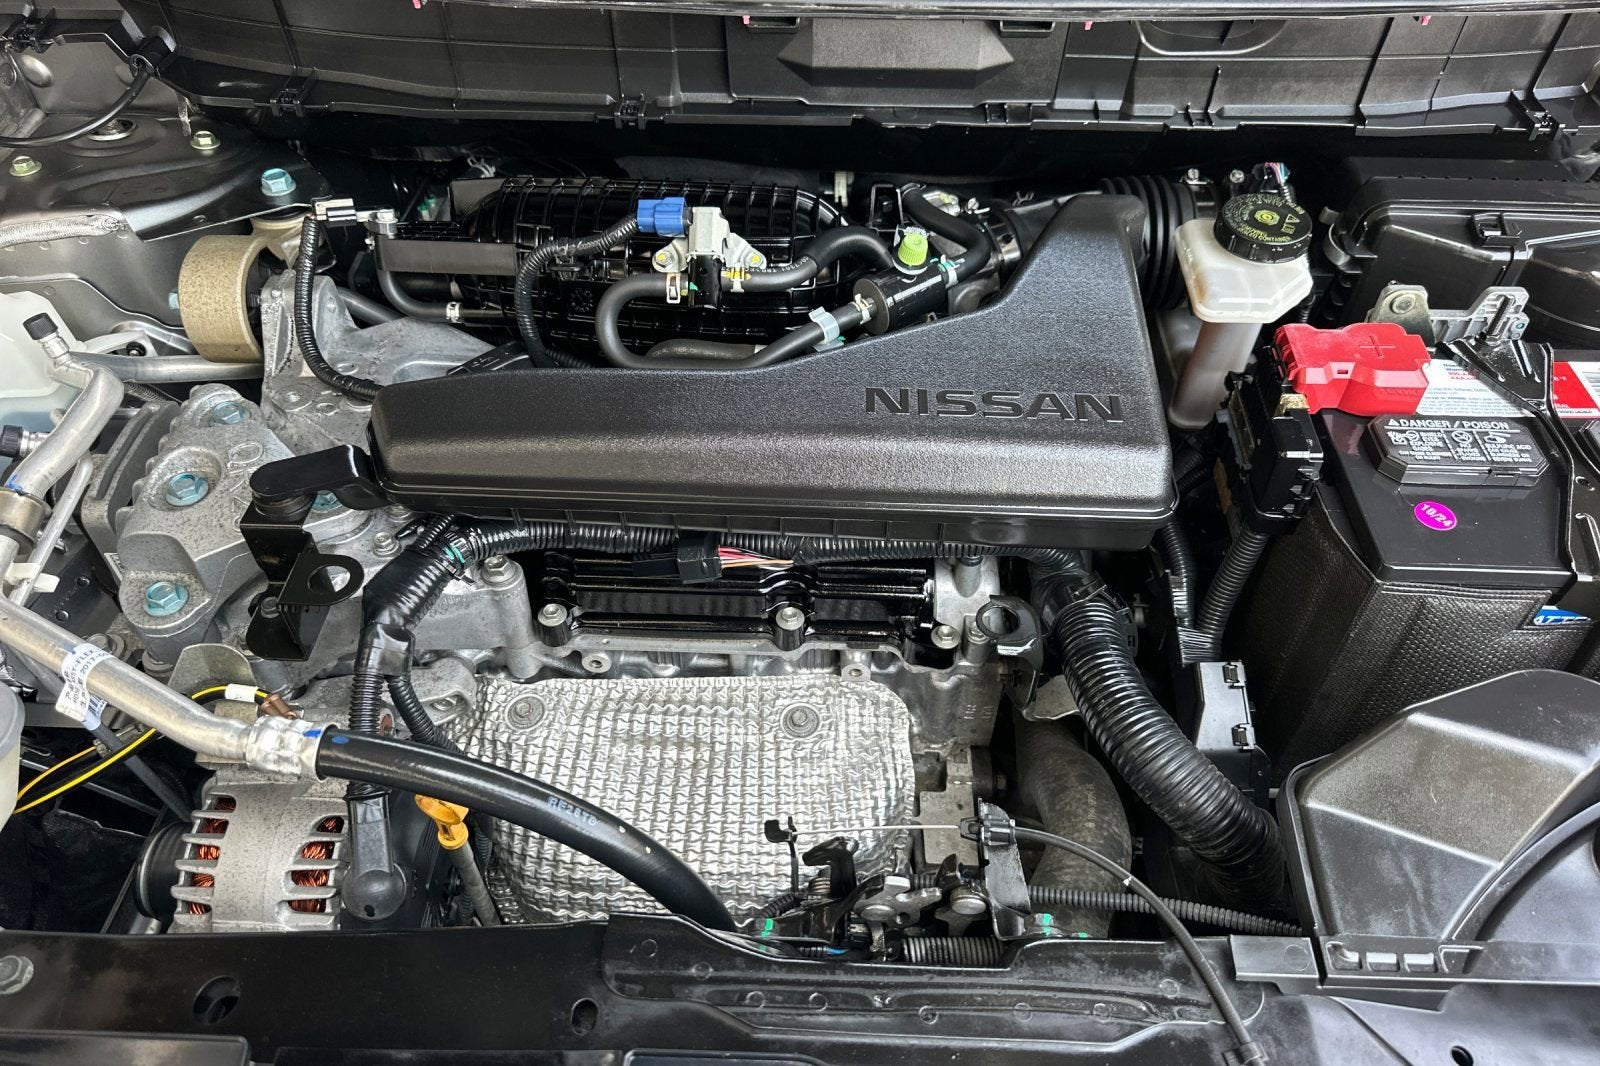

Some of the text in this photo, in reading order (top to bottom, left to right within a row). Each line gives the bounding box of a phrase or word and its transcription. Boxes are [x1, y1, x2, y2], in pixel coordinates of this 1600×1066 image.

[865, 386, 1124, 423] NISSAN
[1400, 419, 1451, 428] DANGER
[1462, 421, 1509, 429] POISON
[1421, 503, 1453, 527] 10/24
